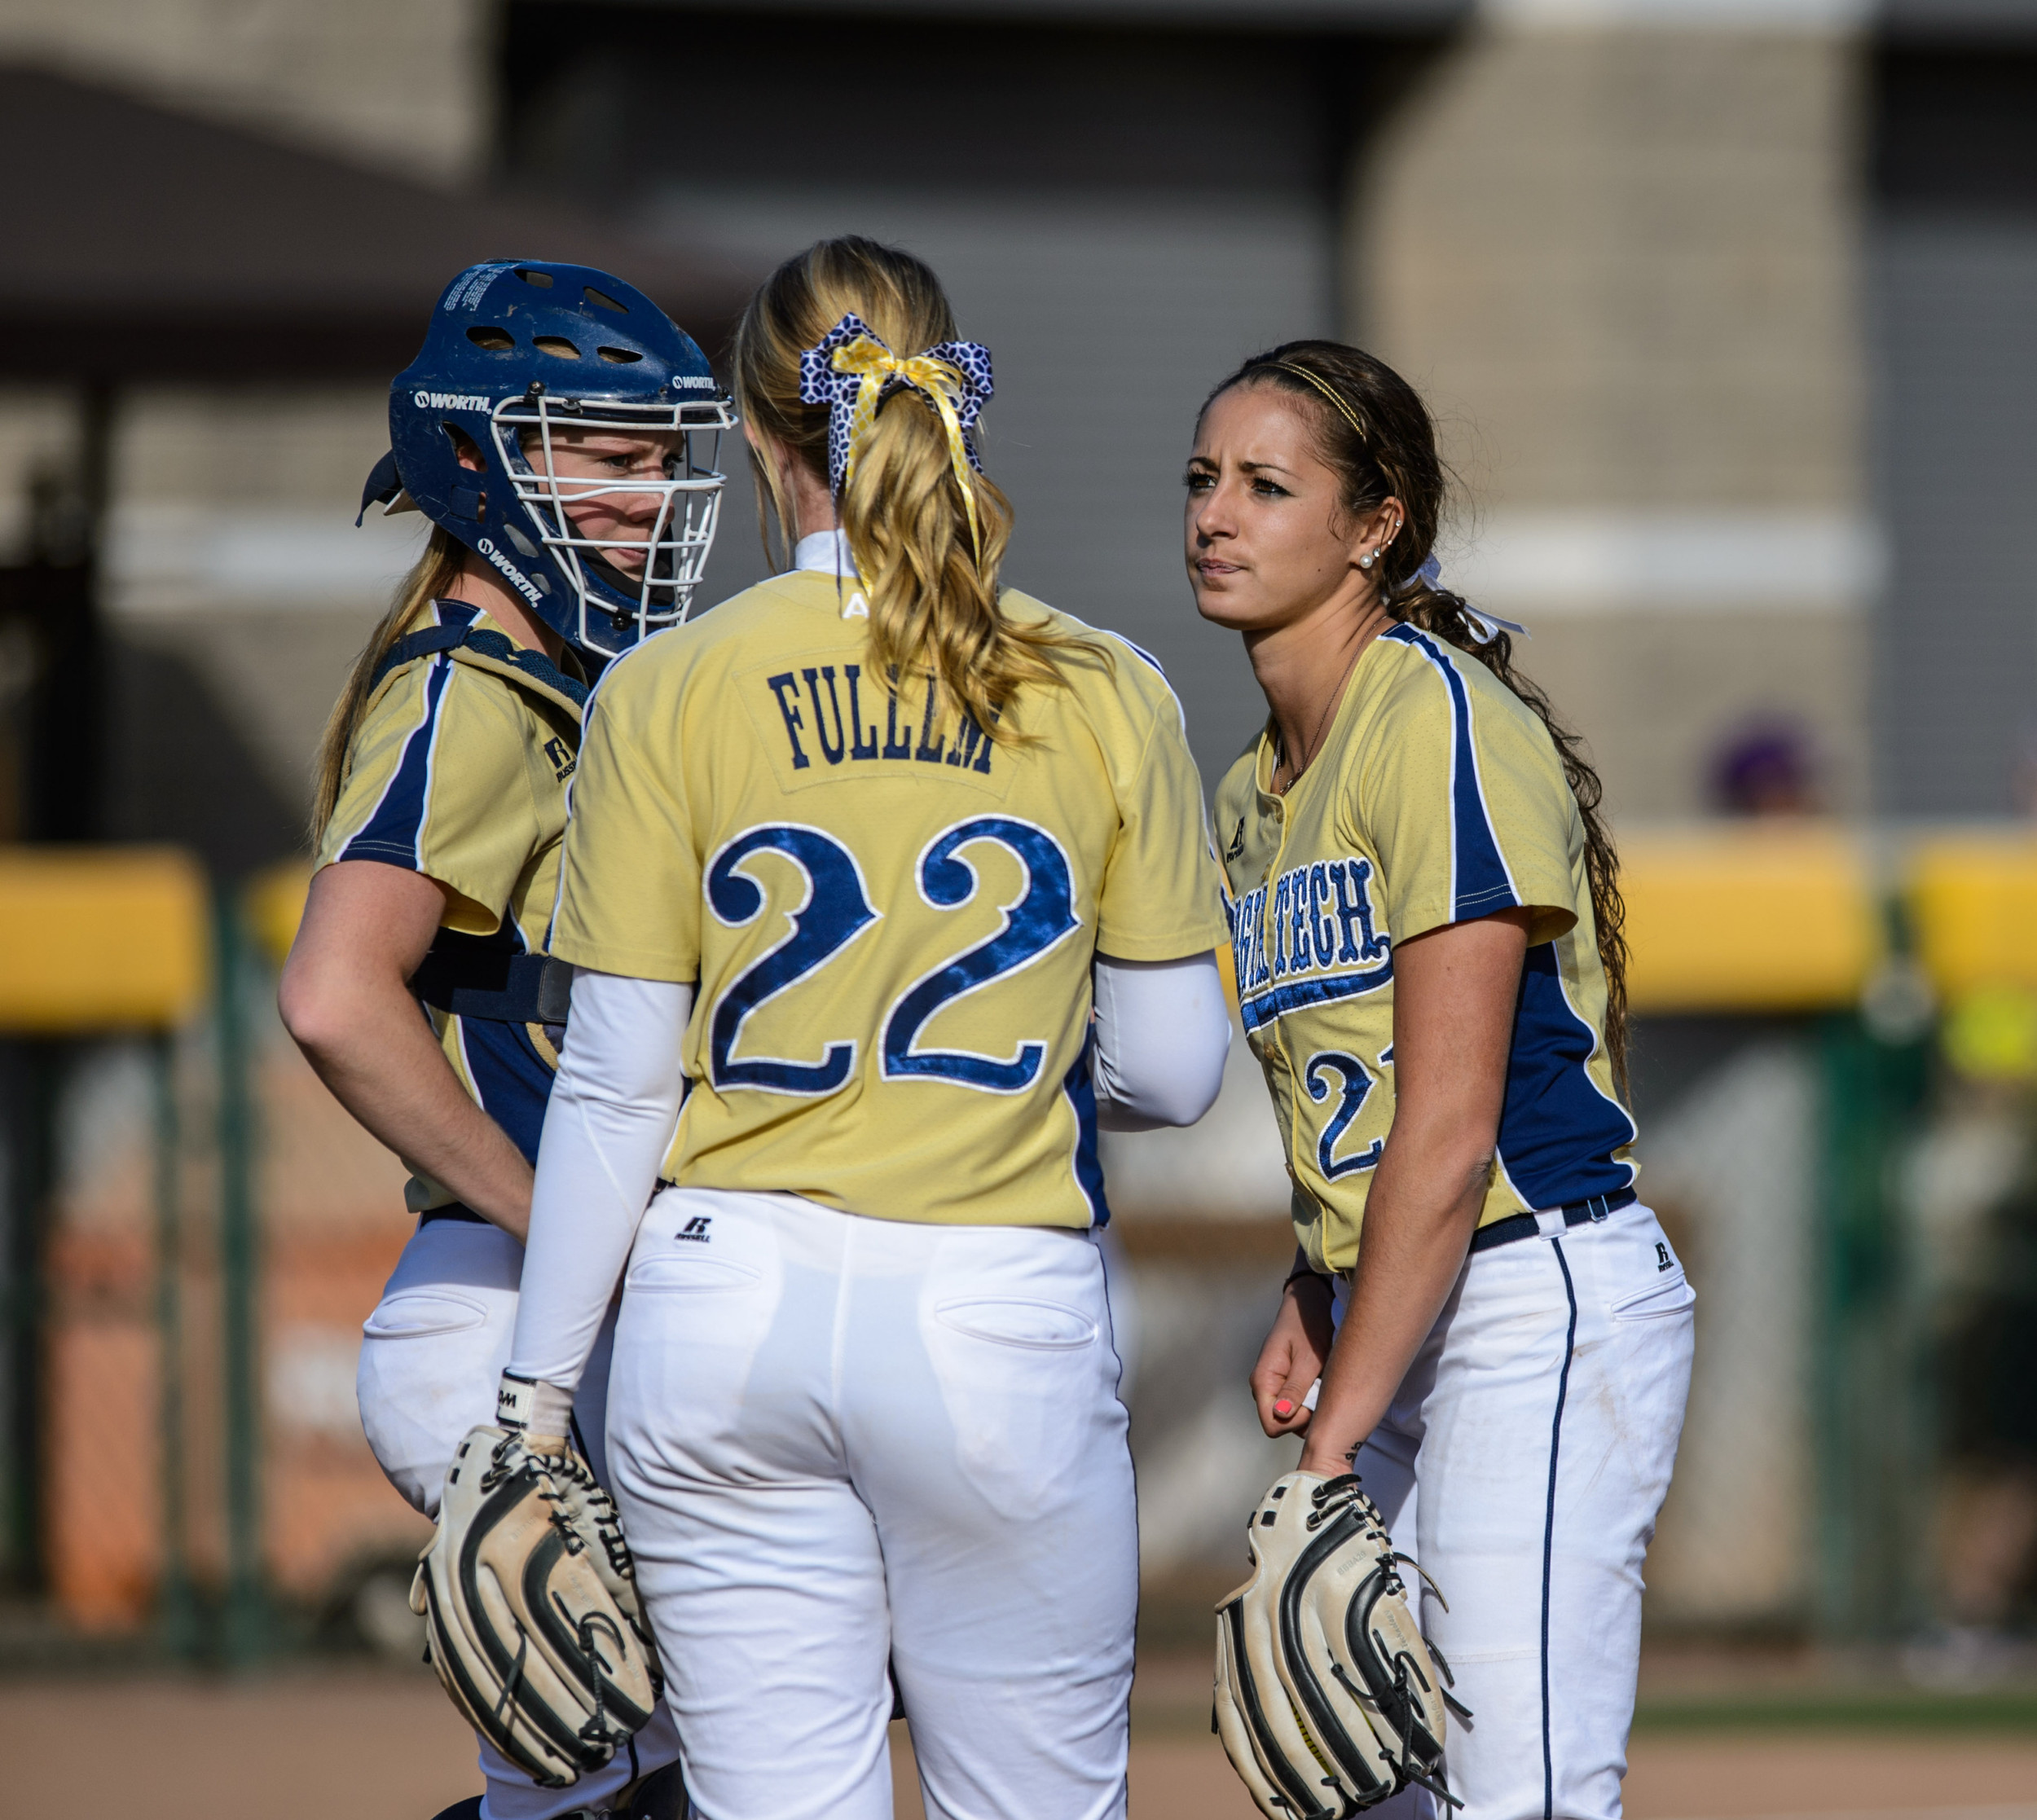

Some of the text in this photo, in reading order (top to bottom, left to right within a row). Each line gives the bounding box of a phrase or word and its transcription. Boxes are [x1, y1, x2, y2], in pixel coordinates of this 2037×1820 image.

[429, 393, 491, 412] WORTH
[682, 376, 714, 389] WORTH
[489, 549, 543, 603] WORTH
[702, 812, 1084, 1097] 22
[1274, 856, 1375, 981] TECH
[1304, 1042, 1394, 1184] 2
